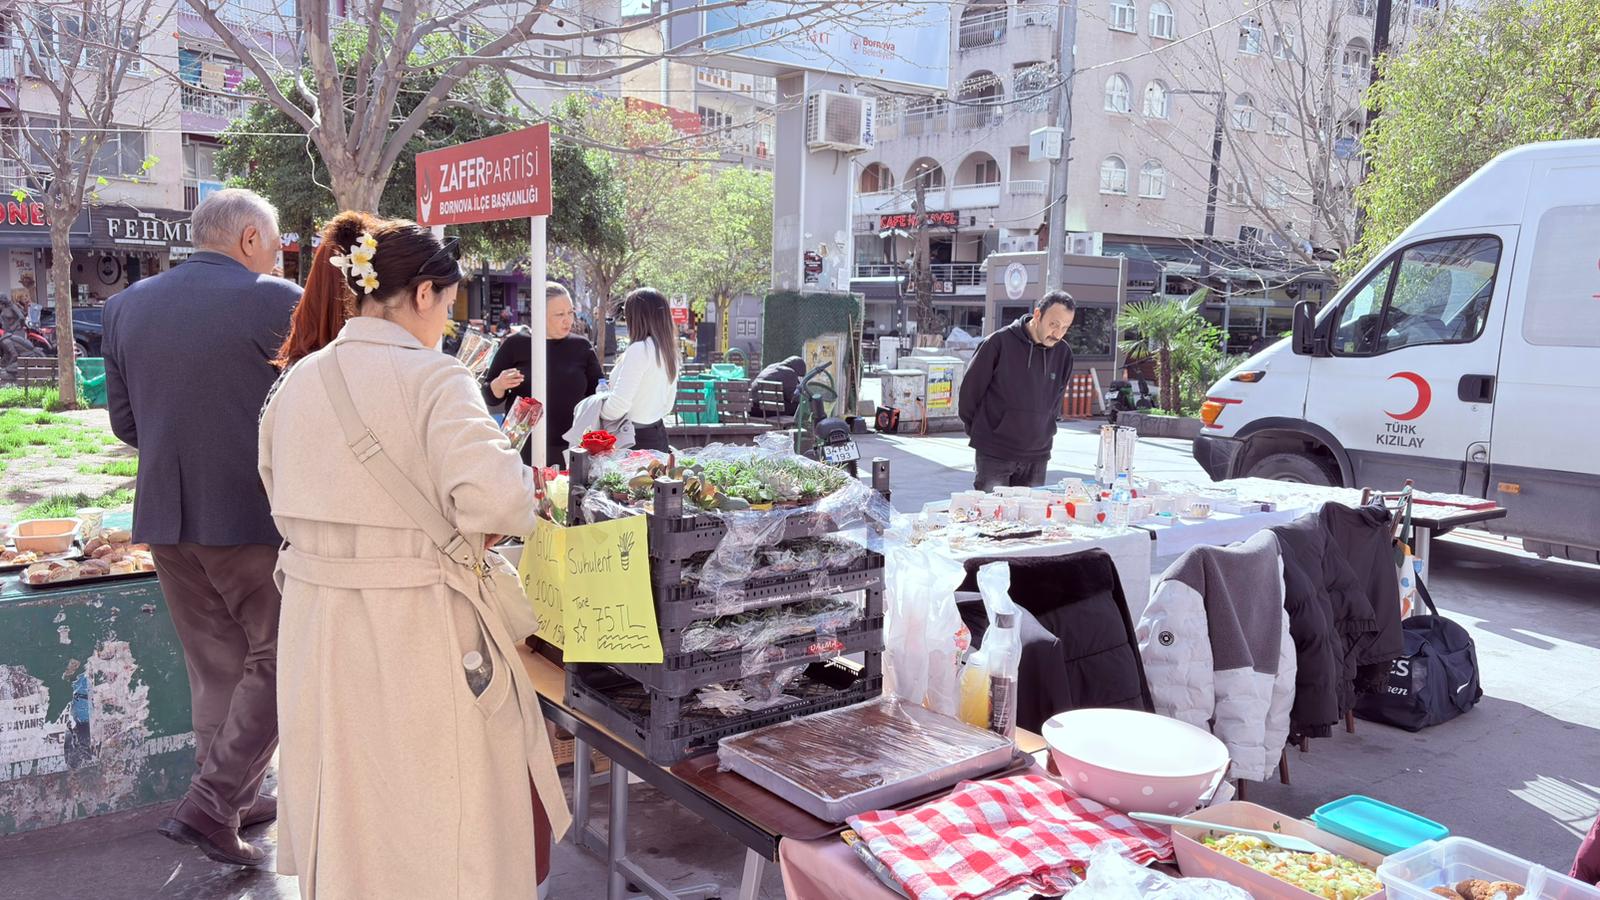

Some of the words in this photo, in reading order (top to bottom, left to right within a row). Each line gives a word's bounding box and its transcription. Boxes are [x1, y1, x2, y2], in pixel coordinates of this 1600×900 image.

[439, 197, 473, 215] BORNOVA
[474, 194, 490, 213] İLÇE
[491, 185, 538, 211] BAŞKANLIĞI
[1385, 421, 1417, 435] TÜRK
[1376, 434, 1425, 448] KIZILAY
[836, 452, 851, 461] 193
